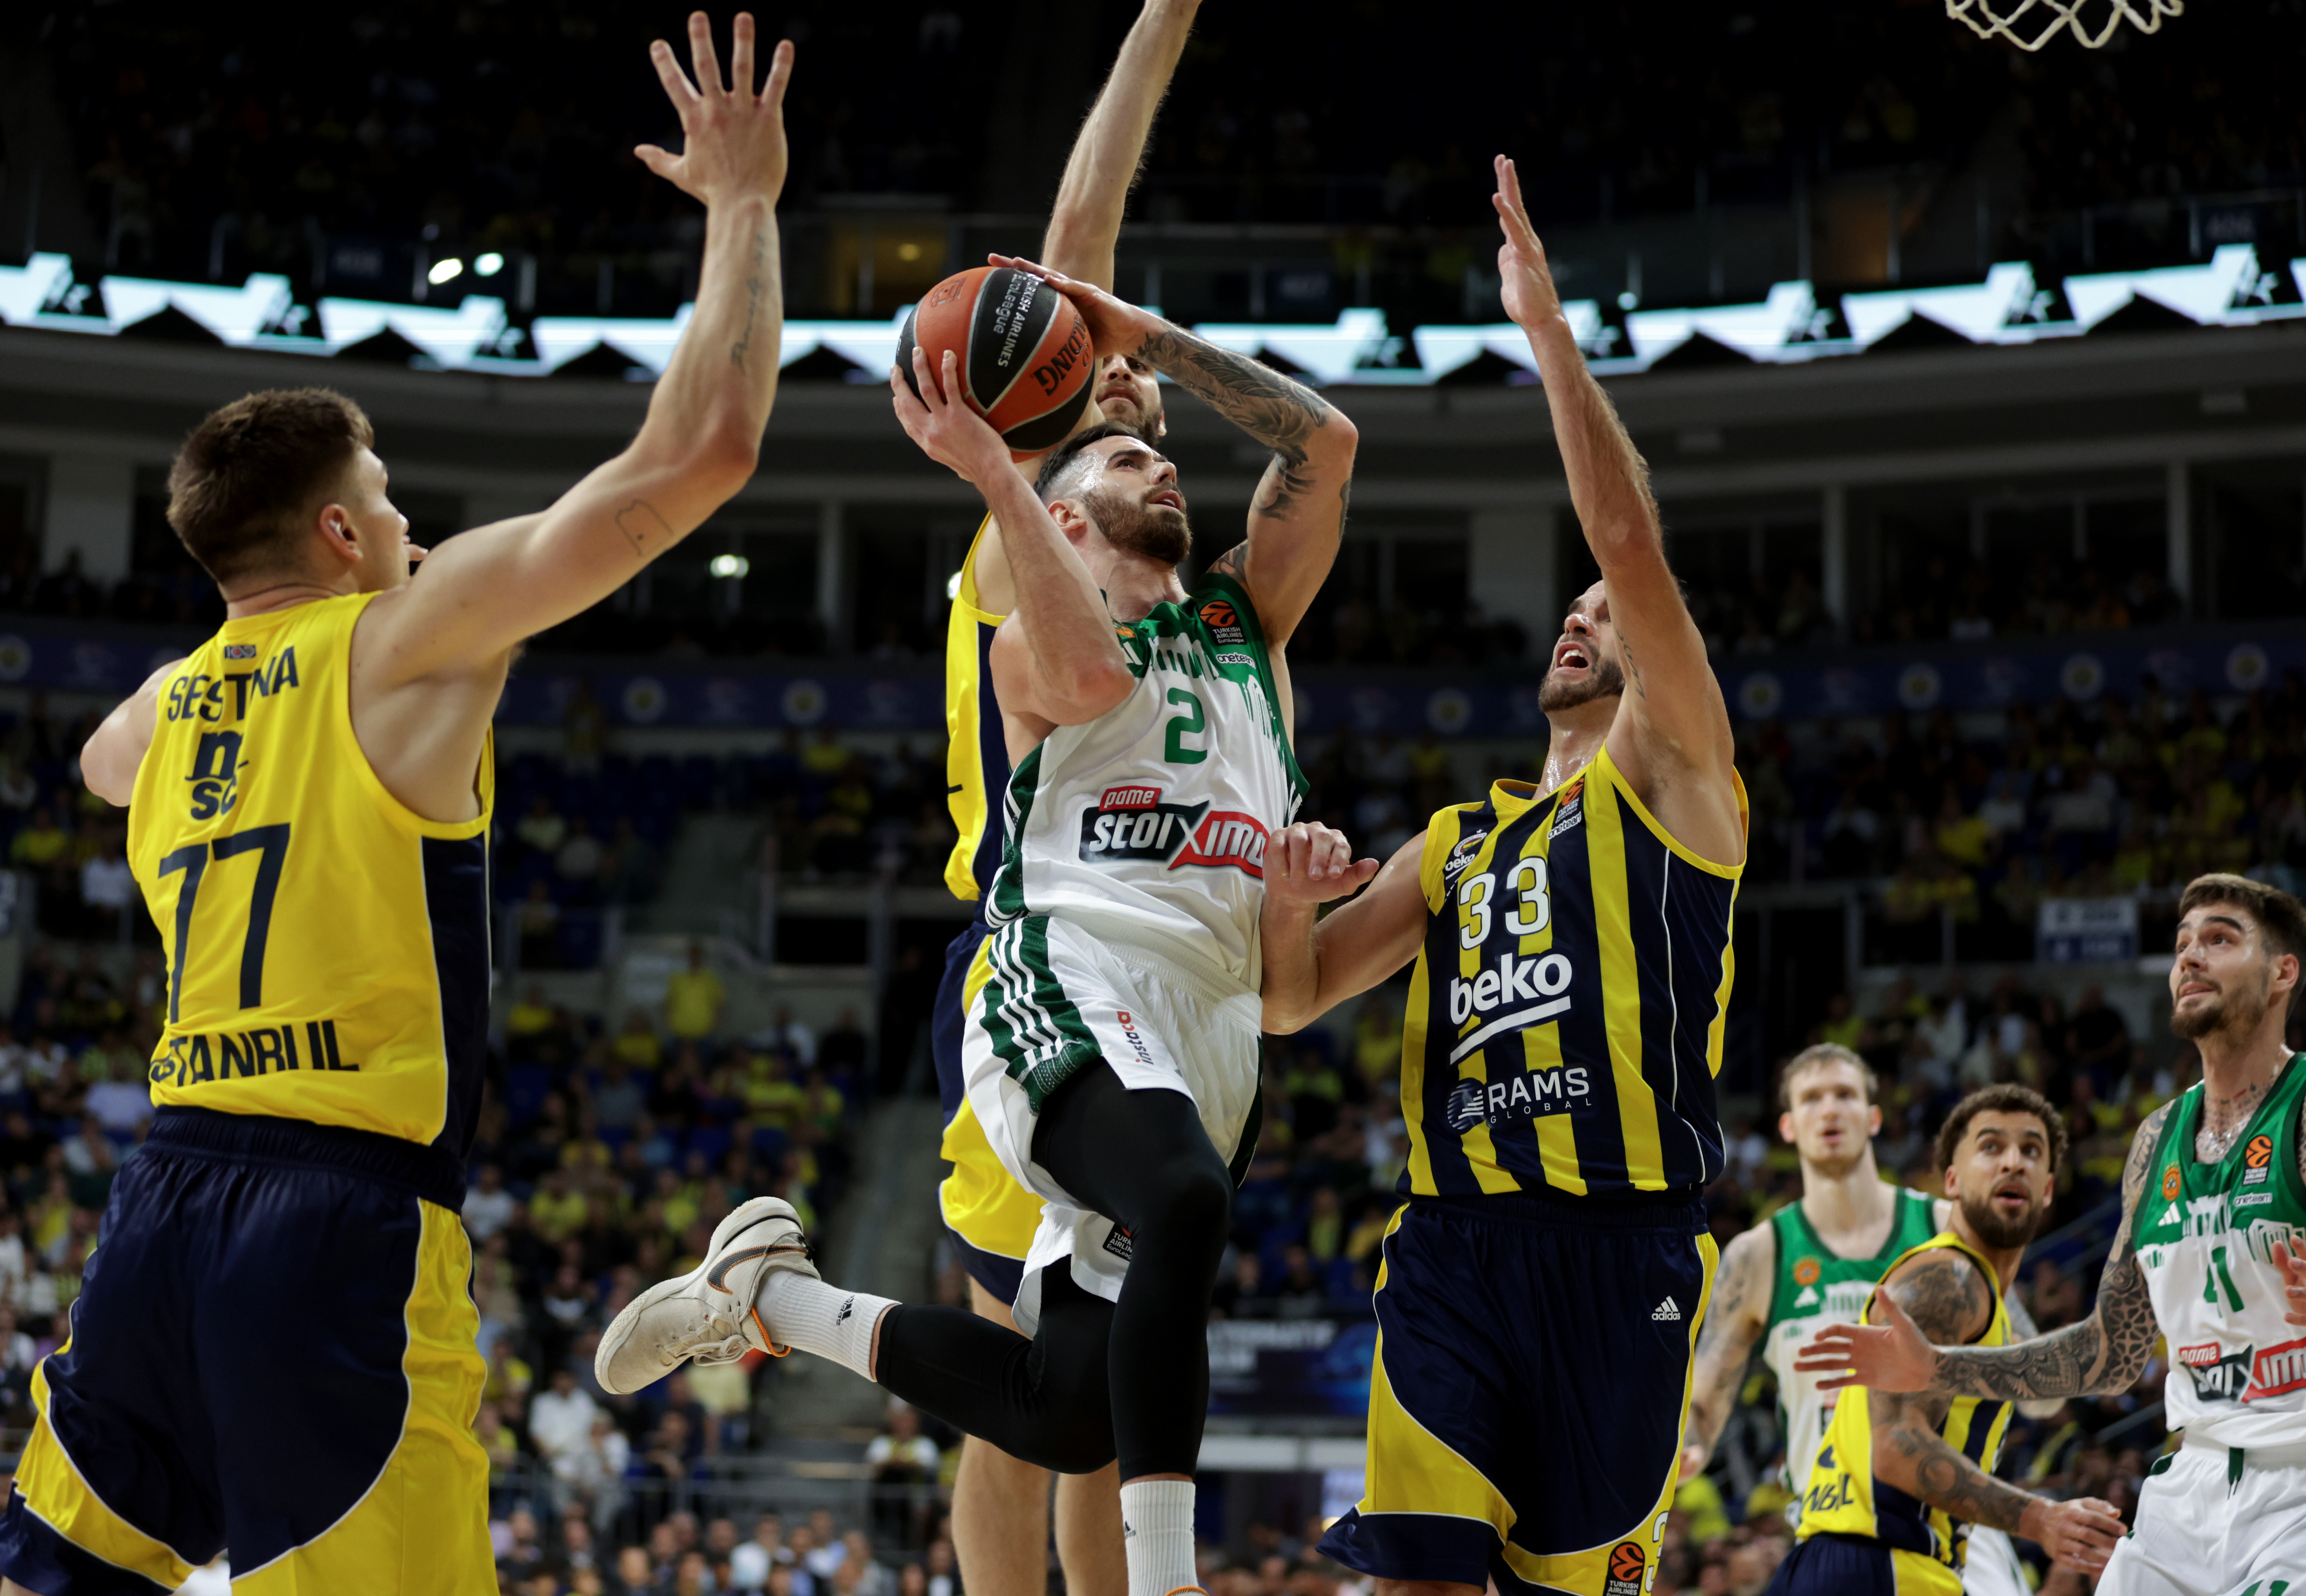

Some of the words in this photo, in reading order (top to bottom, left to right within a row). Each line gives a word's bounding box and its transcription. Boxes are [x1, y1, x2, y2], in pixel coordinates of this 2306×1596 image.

[998, 312, 1025, 367] AIRLINES
[1217, 653, 1256, 669] oneteam
[1164, 687, 1207, 765] 2
[1103, 788, 1155, 809] pame
[1459, 856, 1550, 951] 33
[158, 822, 291, 1024] 77
[1450, 952, 1572, 1026] beko
[1489, 1067, 1589, 1113] RAMS
[1491, 1099, 1592, 1124] GLOBAL
[1110, 1239, 1133, 1253] AIRLIN
[1114, 1232, 1131, 1246] TURK
[1107, 1243, 1131, 1260] EuroLeag
[1651, 1311, 1681, 1321] adidas
[1608, 1586, 1637, 1596] AIRLINES
[1610, 1580, 1638, 1589] TURKISH
